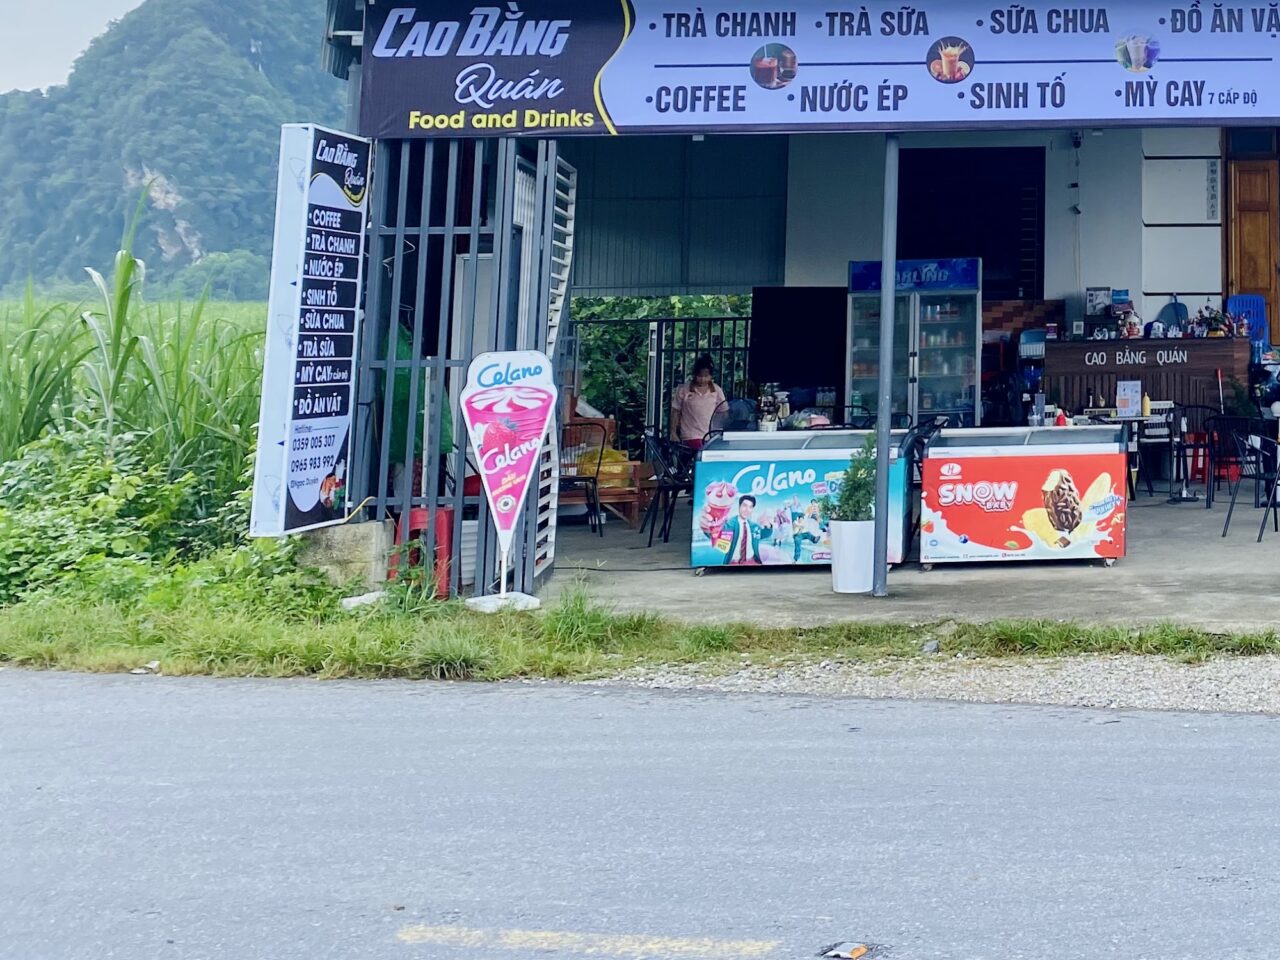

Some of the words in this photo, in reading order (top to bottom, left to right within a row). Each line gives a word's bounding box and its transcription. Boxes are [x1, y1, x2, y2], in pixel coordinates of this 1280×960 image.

[372, 8, 460, 57] CAO
[456, 2, 572, 57] BẰNG
[662, 7, 707, 38] TRÀ
[715, 11, 796, 37] CHANH
[825, 6, 872, 37] TRÀ
[880, 6, 929, 36] SỮA
[990, 4, 1039, 34] SỮA
[1046, 8, 1110, 33] CHUA
[1170, 0, 1202, 33] ĐỒ
[1210, 3, 1243, 33] ĂN
[454, 62, 564, 109] Quán
[800, 79, 868, 112] NƯỚC
[877, 79, 908, 111] ÉP
[969, 82, 1028, 109] SINH
[1036, 72, 1066, 108] TỐ
[1125, 75, 1158, 107] MỲ
[1166, 80, 1206, 107] CAY
[1208, 93, 1215, 104] 7
[1218, 87, 1240, 104] CẤP
[1243, 90, 1258, 107] ĐỘ
[655, 85, 746, 113] COFFEE
[409, 110, 465, 129] Food
[472, 109, 517, 128] and
[524, 109, 594, 127] Drinks
[316, 140, 335, 162] CAO
[313, 209, 341, 228] COFFEE
[311, 231, 326, 251] TRÀ
[327, 236, 355, 253] CHANH
[309, 256, 334, 277] NƯỚC
[334, 257, 344, 278] ÉP
[306, 289, 326, 306] SINH
[327, 281, 338, 306] TỐ
[322, 313, 345, 330] CHUA
[303, 335, 319, 357] TRÀ
[1085, 351, 1107, 365] CAO
[1156, 346, 1188, 366] QUÁN
[301, 361, 315, 382] MỲ
[316, 365, 333, 382] CAY
[477, 362, 543, 388] Celano
[299, 389, 312, 415] ĐỒ
[313, 393, 325, 414] ĂN
[326, 392, 342, 417] VẶT
[292, 437, 309, 451] 0359
[310, 436, 322, 449] 005
[324, 434, 335, 447] 307
[291, 458, 307, 472] 0965
[309, 456, 320, 470] 983
[322, 454, 334, 468] 992
[482, 437, 542, 475] Celano
[732, 464, 816, 496] Celano
[938, 481, 1018, 507] SNOW
[985, 501, 1013, 511] BABY
